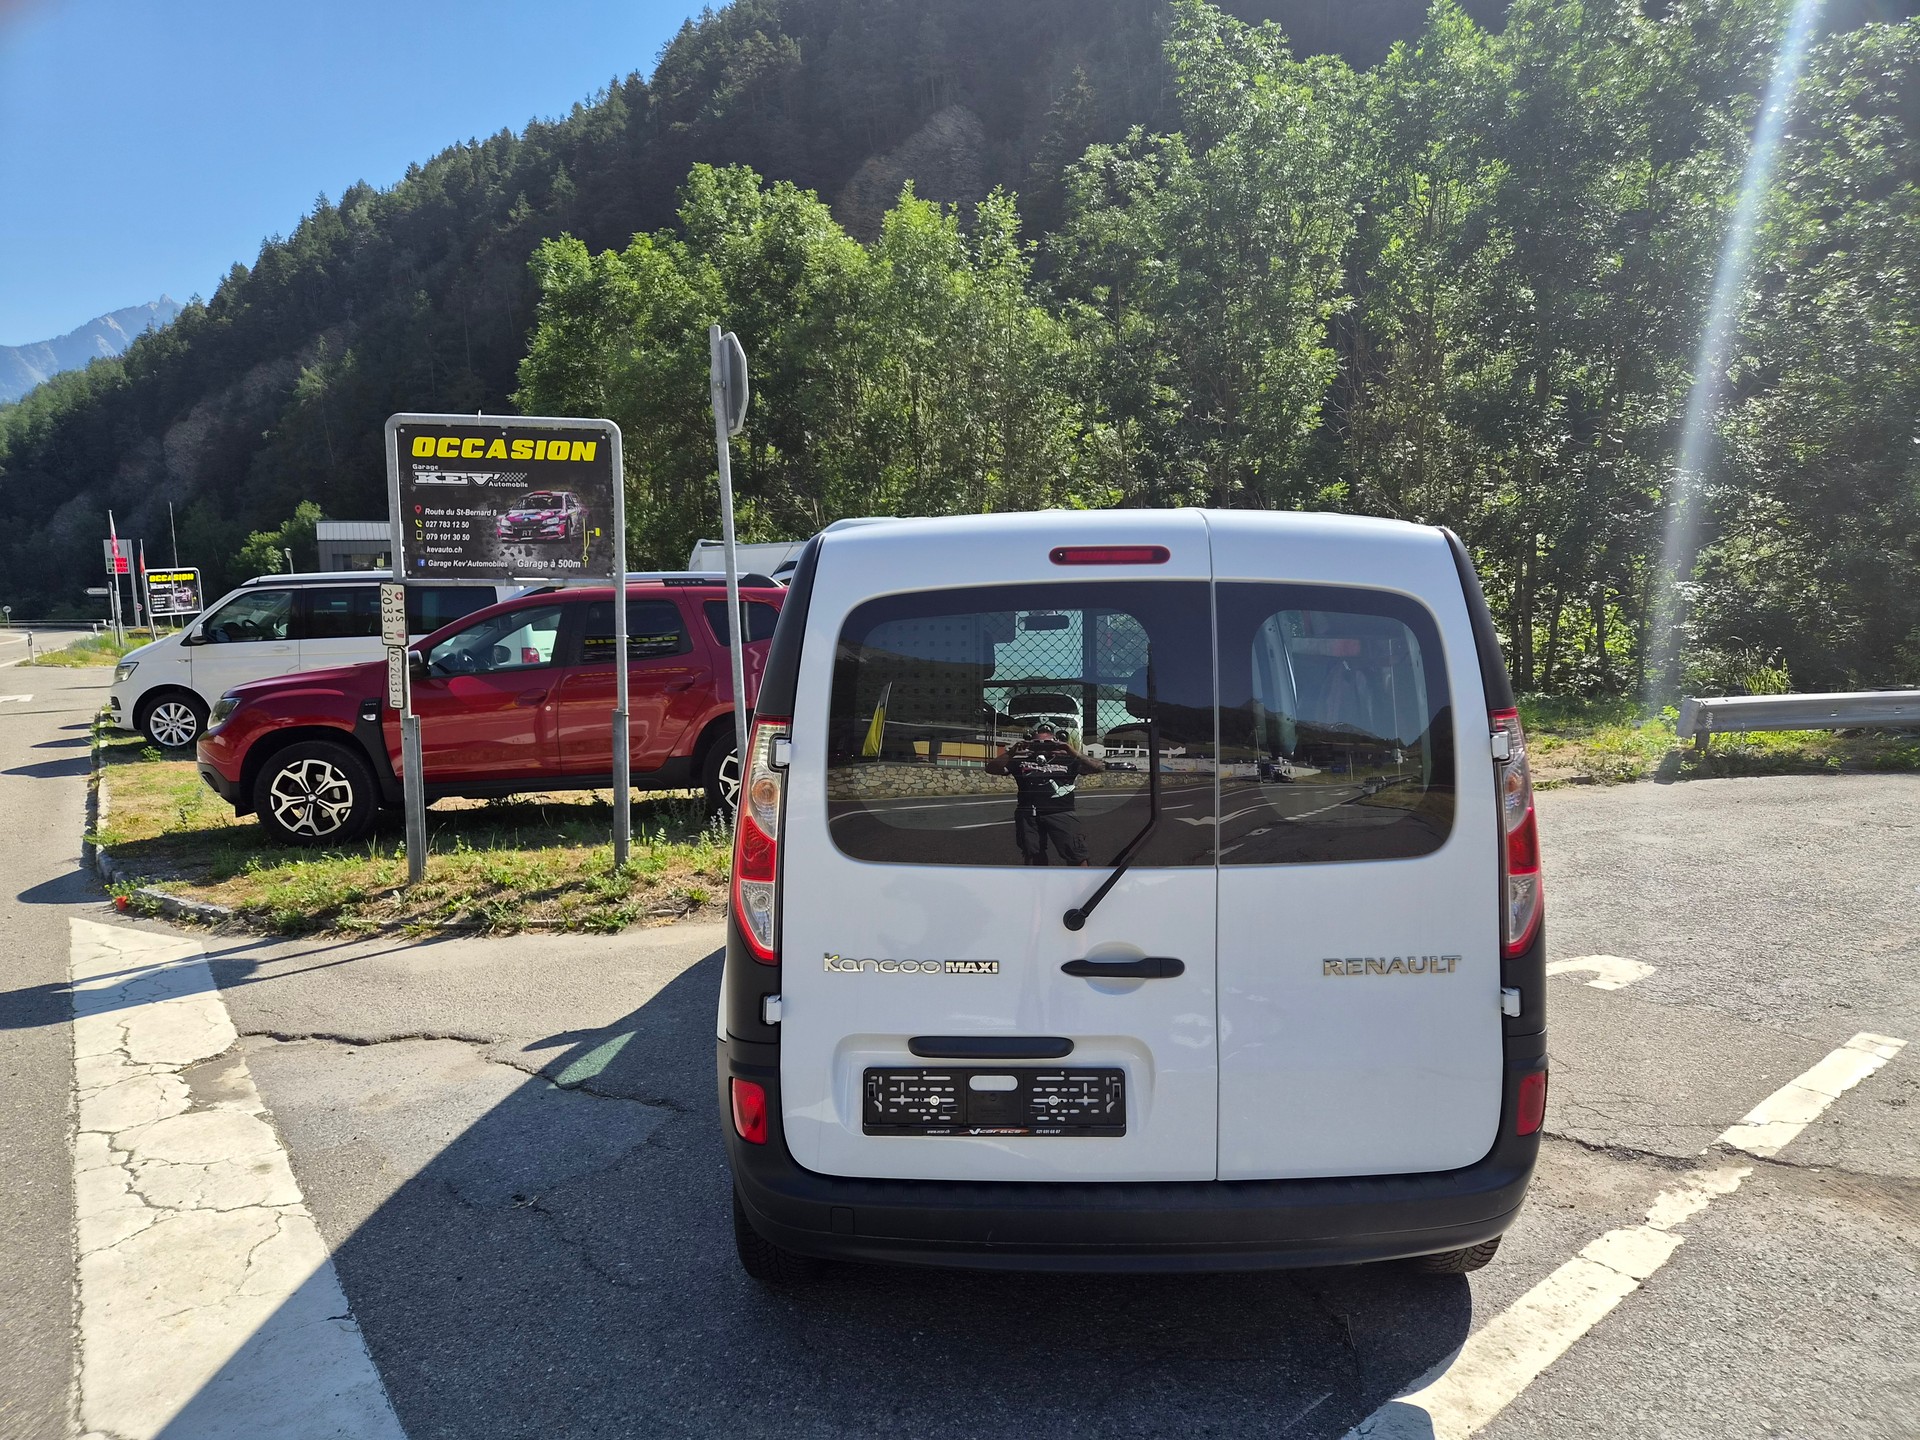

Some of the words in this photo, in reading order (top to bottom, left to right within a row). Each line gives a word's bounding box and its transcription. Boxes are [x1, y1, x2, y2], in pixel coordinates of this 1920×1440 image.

[411, 436, 597, 462] OCCASION
[412, 463, 439, 471] Garage
[424, 507, 445, 516] Route
[445, 508, 455, 516] du
[456, 508, 492, 517] St-Bernard
[492, 509, 497, 517] 8
[425, 520, 438, 528] 027
[438, 520, 451, 528] 783
[425, 533, 438, 541] 079
[439, 533, 451, 541] 101
[452, 533, 460, 541] 30
[461, 533, 470, 541] 50
[426, 545, 463, 553] kevauto.ch
[427, 559, 452, 568] Garage
[453, 559, 508, 568] Kev'Automobiles
[517, 558, 549, 570] Garage
[550, 558, 556, 568] à
[558, 559, 581, 568] 500m
[395, 608, 404, 622] VS
[823, 952, 942, 975] Kangoo
[944, 960, 1000, 974] MAXI
[1322, 954, 1463, 977] RENAULT
